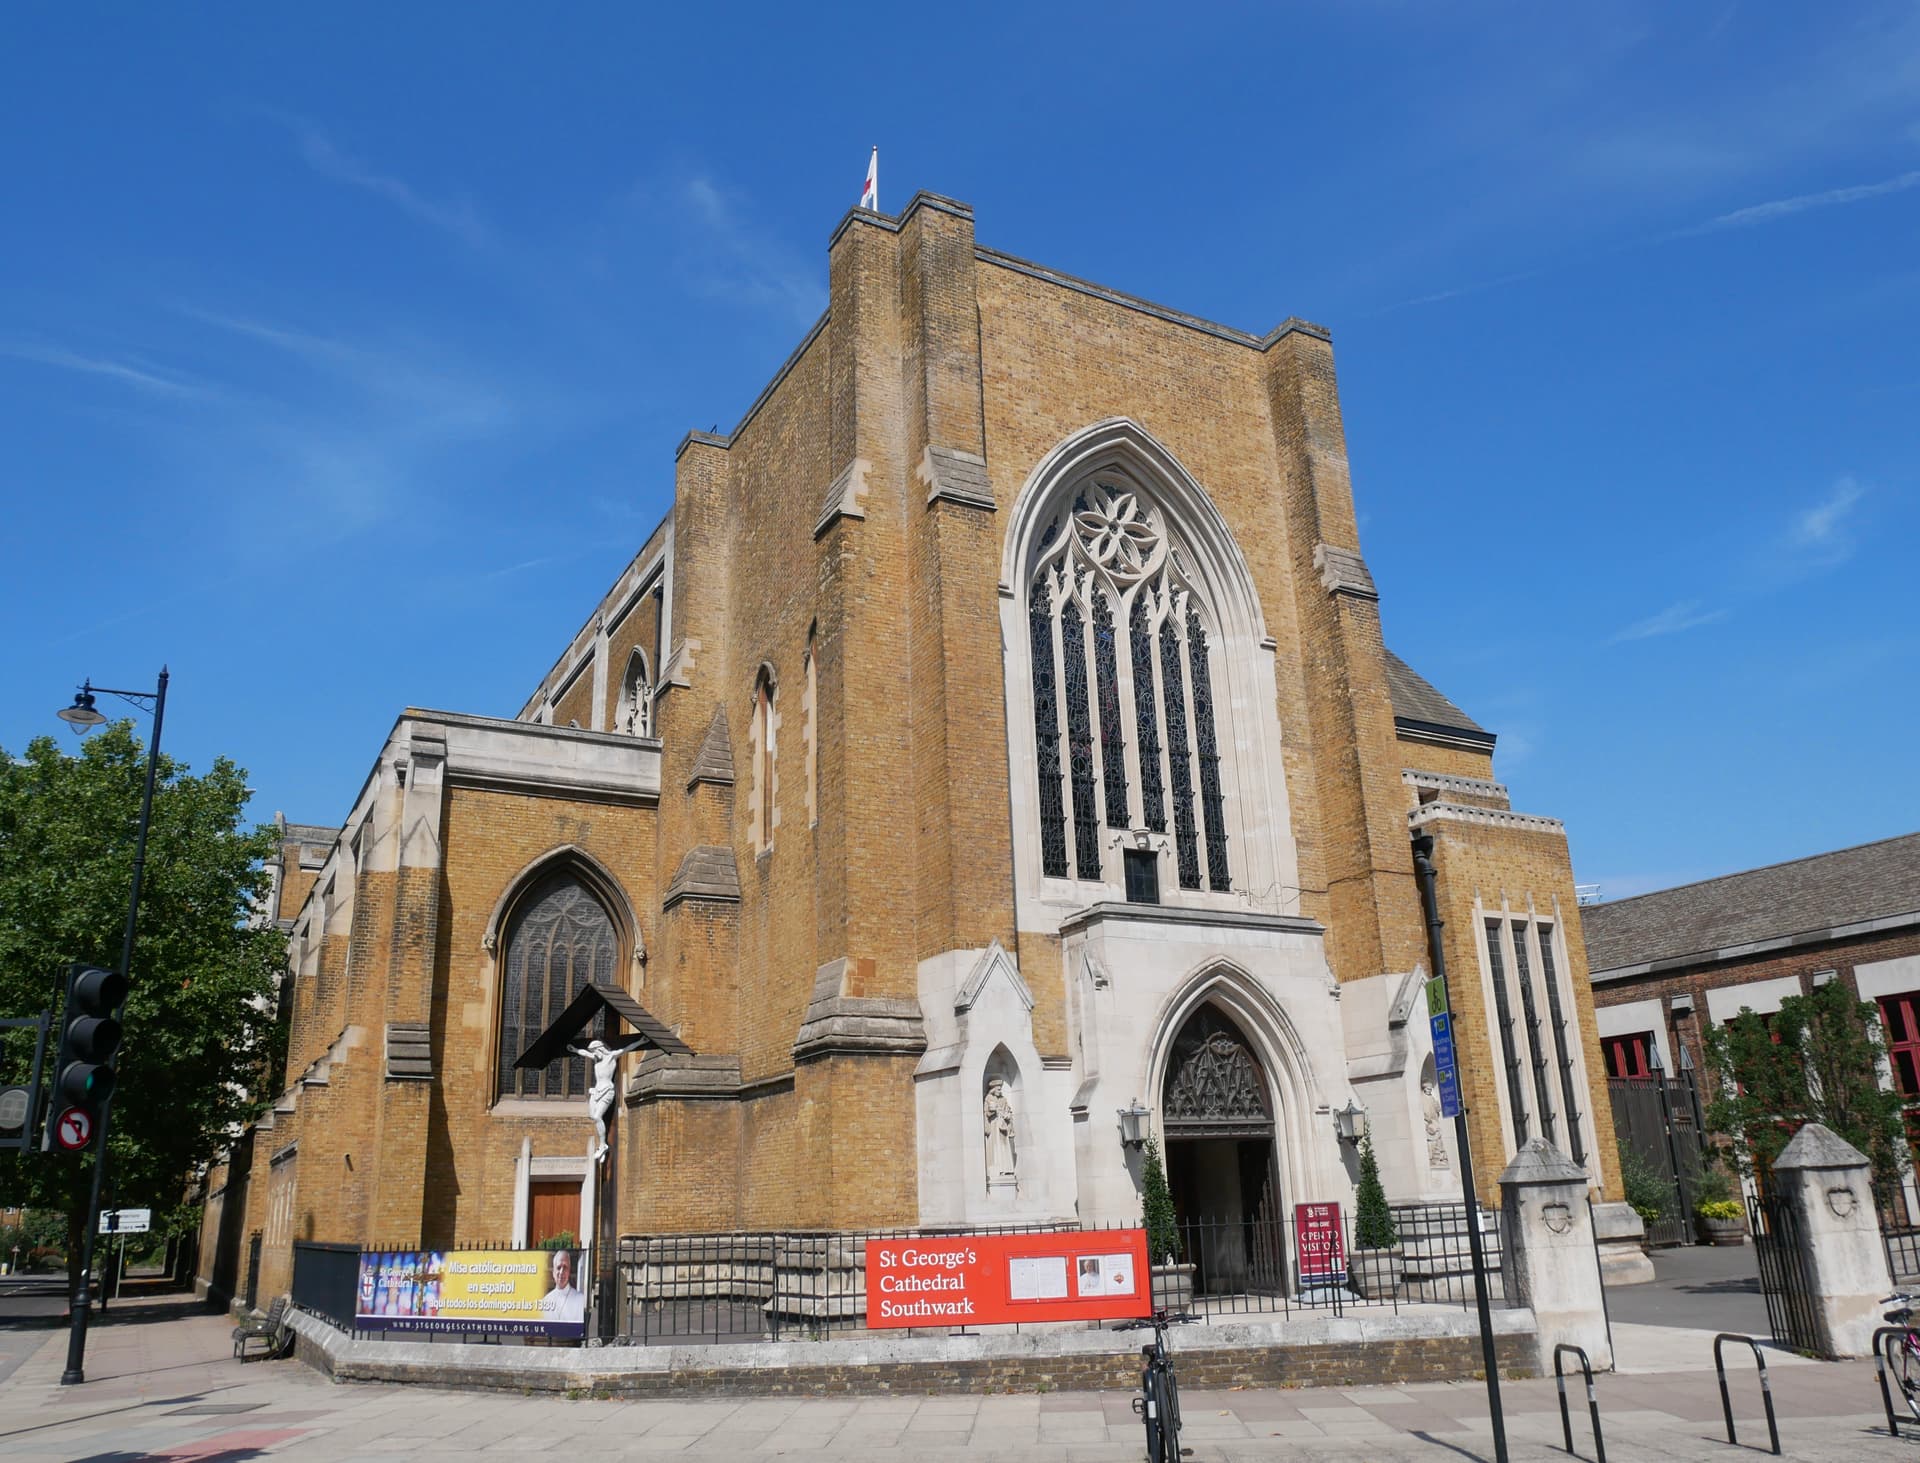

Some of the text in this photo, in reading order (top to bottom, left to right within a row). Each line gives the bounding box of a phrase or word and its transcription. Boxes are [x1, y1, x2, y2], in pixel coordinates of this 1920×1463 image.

[1302, 1241, 1340, 1251] VISIOS
[880, 1248, 976, 1269] St George's
[448, 1260, 537, 1274] Misa católica romana
[467, 1280, 515, 1296] en español
[880, 1273, 965, 1292] Cathedral
[447, 1298, 465, 1309] todos
[467, 1298, 478, 1309] los
[479, 1299, 516, 1313] domingos
[522, 1298, 533, 1310] las
[881, 1297, 975, 1317] Southwark
